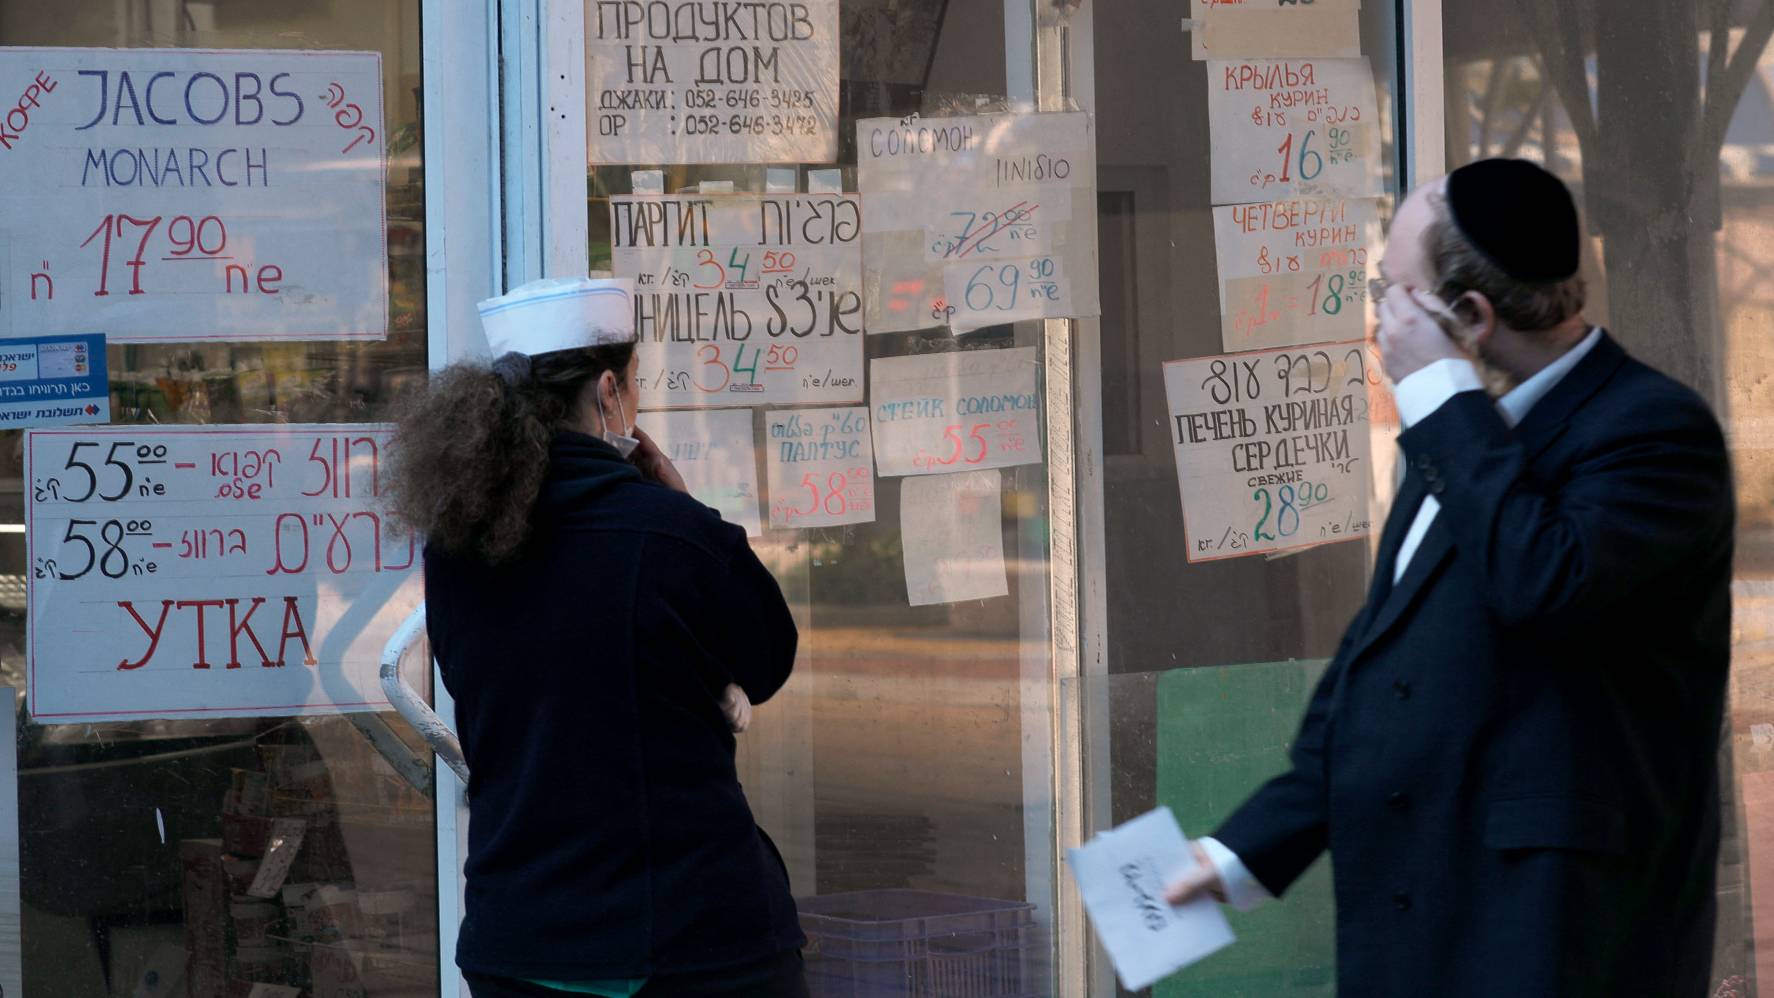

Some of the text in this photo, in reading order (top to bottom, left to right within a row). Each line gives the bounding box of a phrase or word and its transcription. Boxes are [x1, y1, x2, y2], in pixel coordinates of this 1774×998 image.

[596, 1, 814, 43] ПРОДУКТОВ
[625, 45, 781, 87] НА ДОМ
[1225, 62, 1316, 91] КРЫЛЬЯ
[75, 71, 304, 130] JACOBS
[1270, 89, 1329, 109] КУРИН
[82, 148, 268, 187] MONARCH
[611, 200, 861, 247] ПАРГИТ פרגיות
[1295, 224, 1357, 247] КУРИН
[634, 280, 862, 344] НИЦЕЛЬ שניצל
[29, 383, 68, 395] תרוויחו
[71, 381, 90, 397] כאן
[0, 406, 83, 421] תשלובת ישרא
[1175, 408, 1257, 445] ПЕЧЕНЬ
[1264, 394, 1355, 435] КУРИНАЯ
[301, 437, 380, 498] רווז
[1231, 429, 1352, 473] СЕРДЕЧКИ
[117, 597, 317, 671] УТКА
